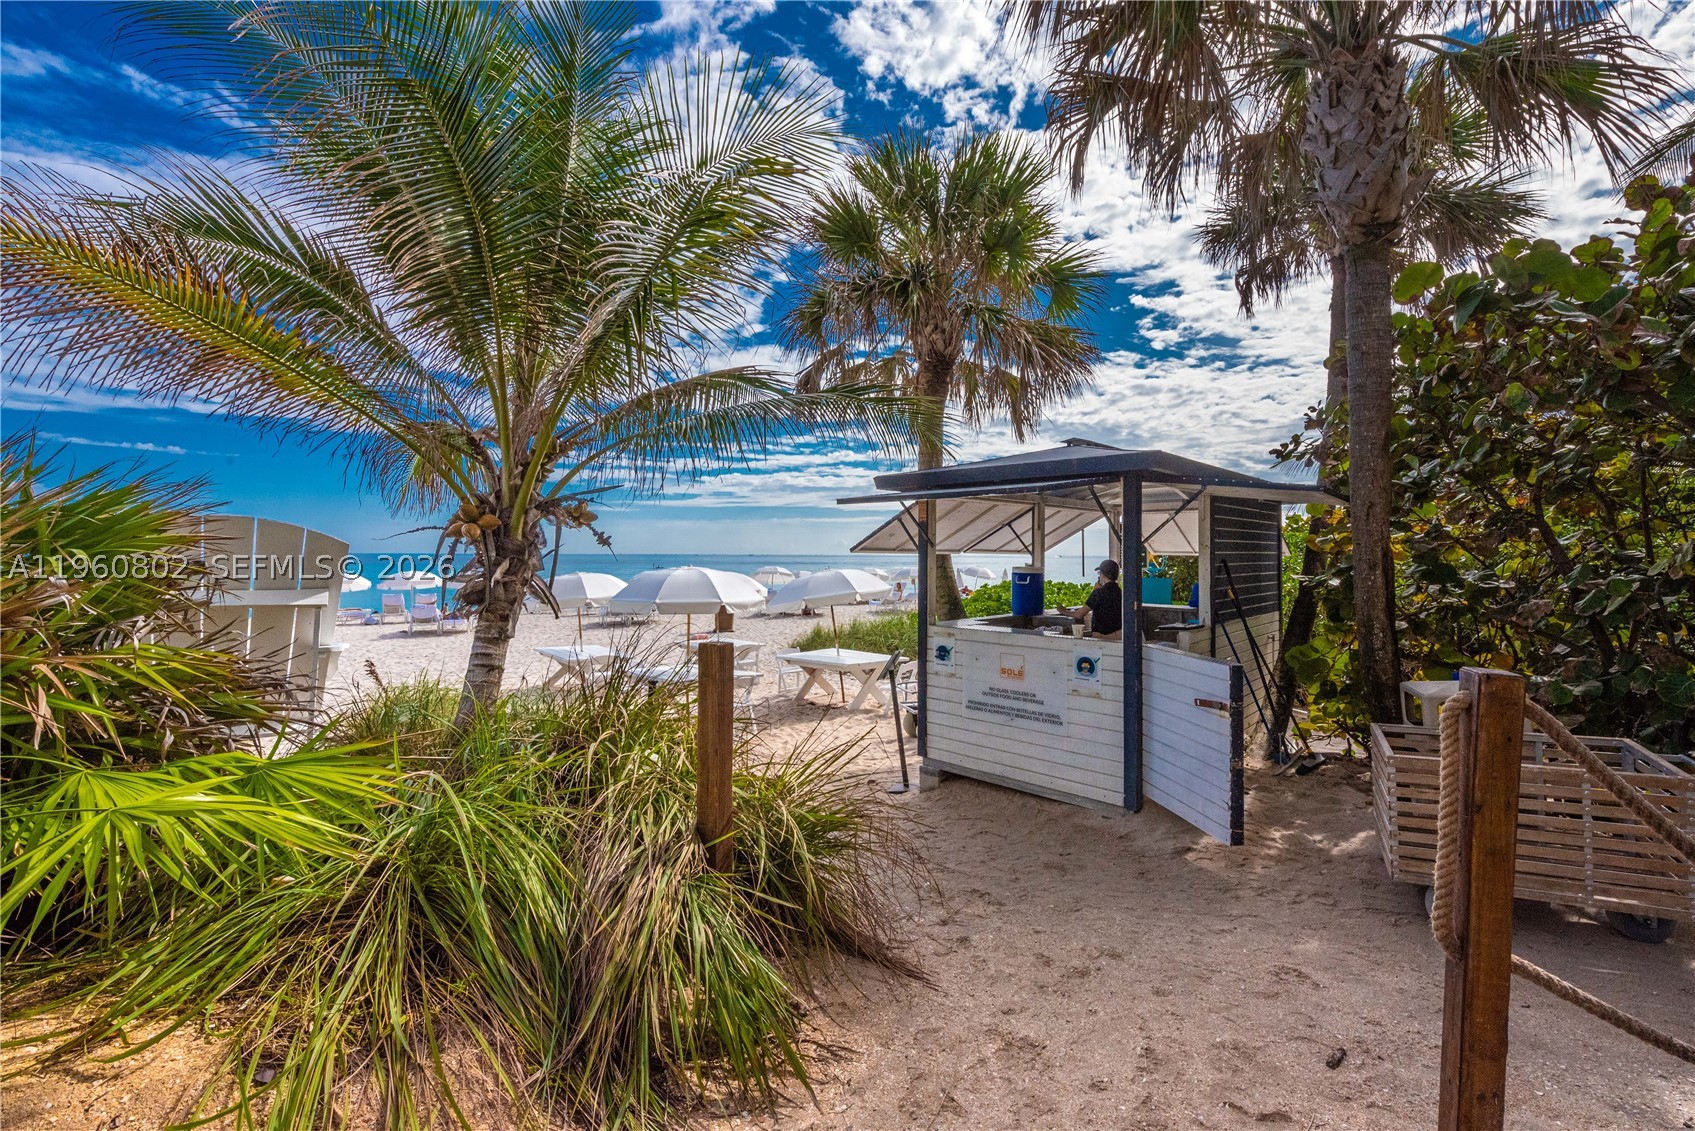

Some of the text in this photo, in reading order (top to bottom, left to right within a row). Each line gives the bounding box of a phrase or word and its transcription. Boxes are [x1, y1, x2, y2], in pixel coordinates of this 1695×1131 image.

[1001, 666, 1024, 677] SOLÉ
[988, 709, 1011, 717] ALIMENTOS
[1041, 718, 1063, 726] EXTERIOR
[1016, 708, 1037, 716] BOTELLAS
